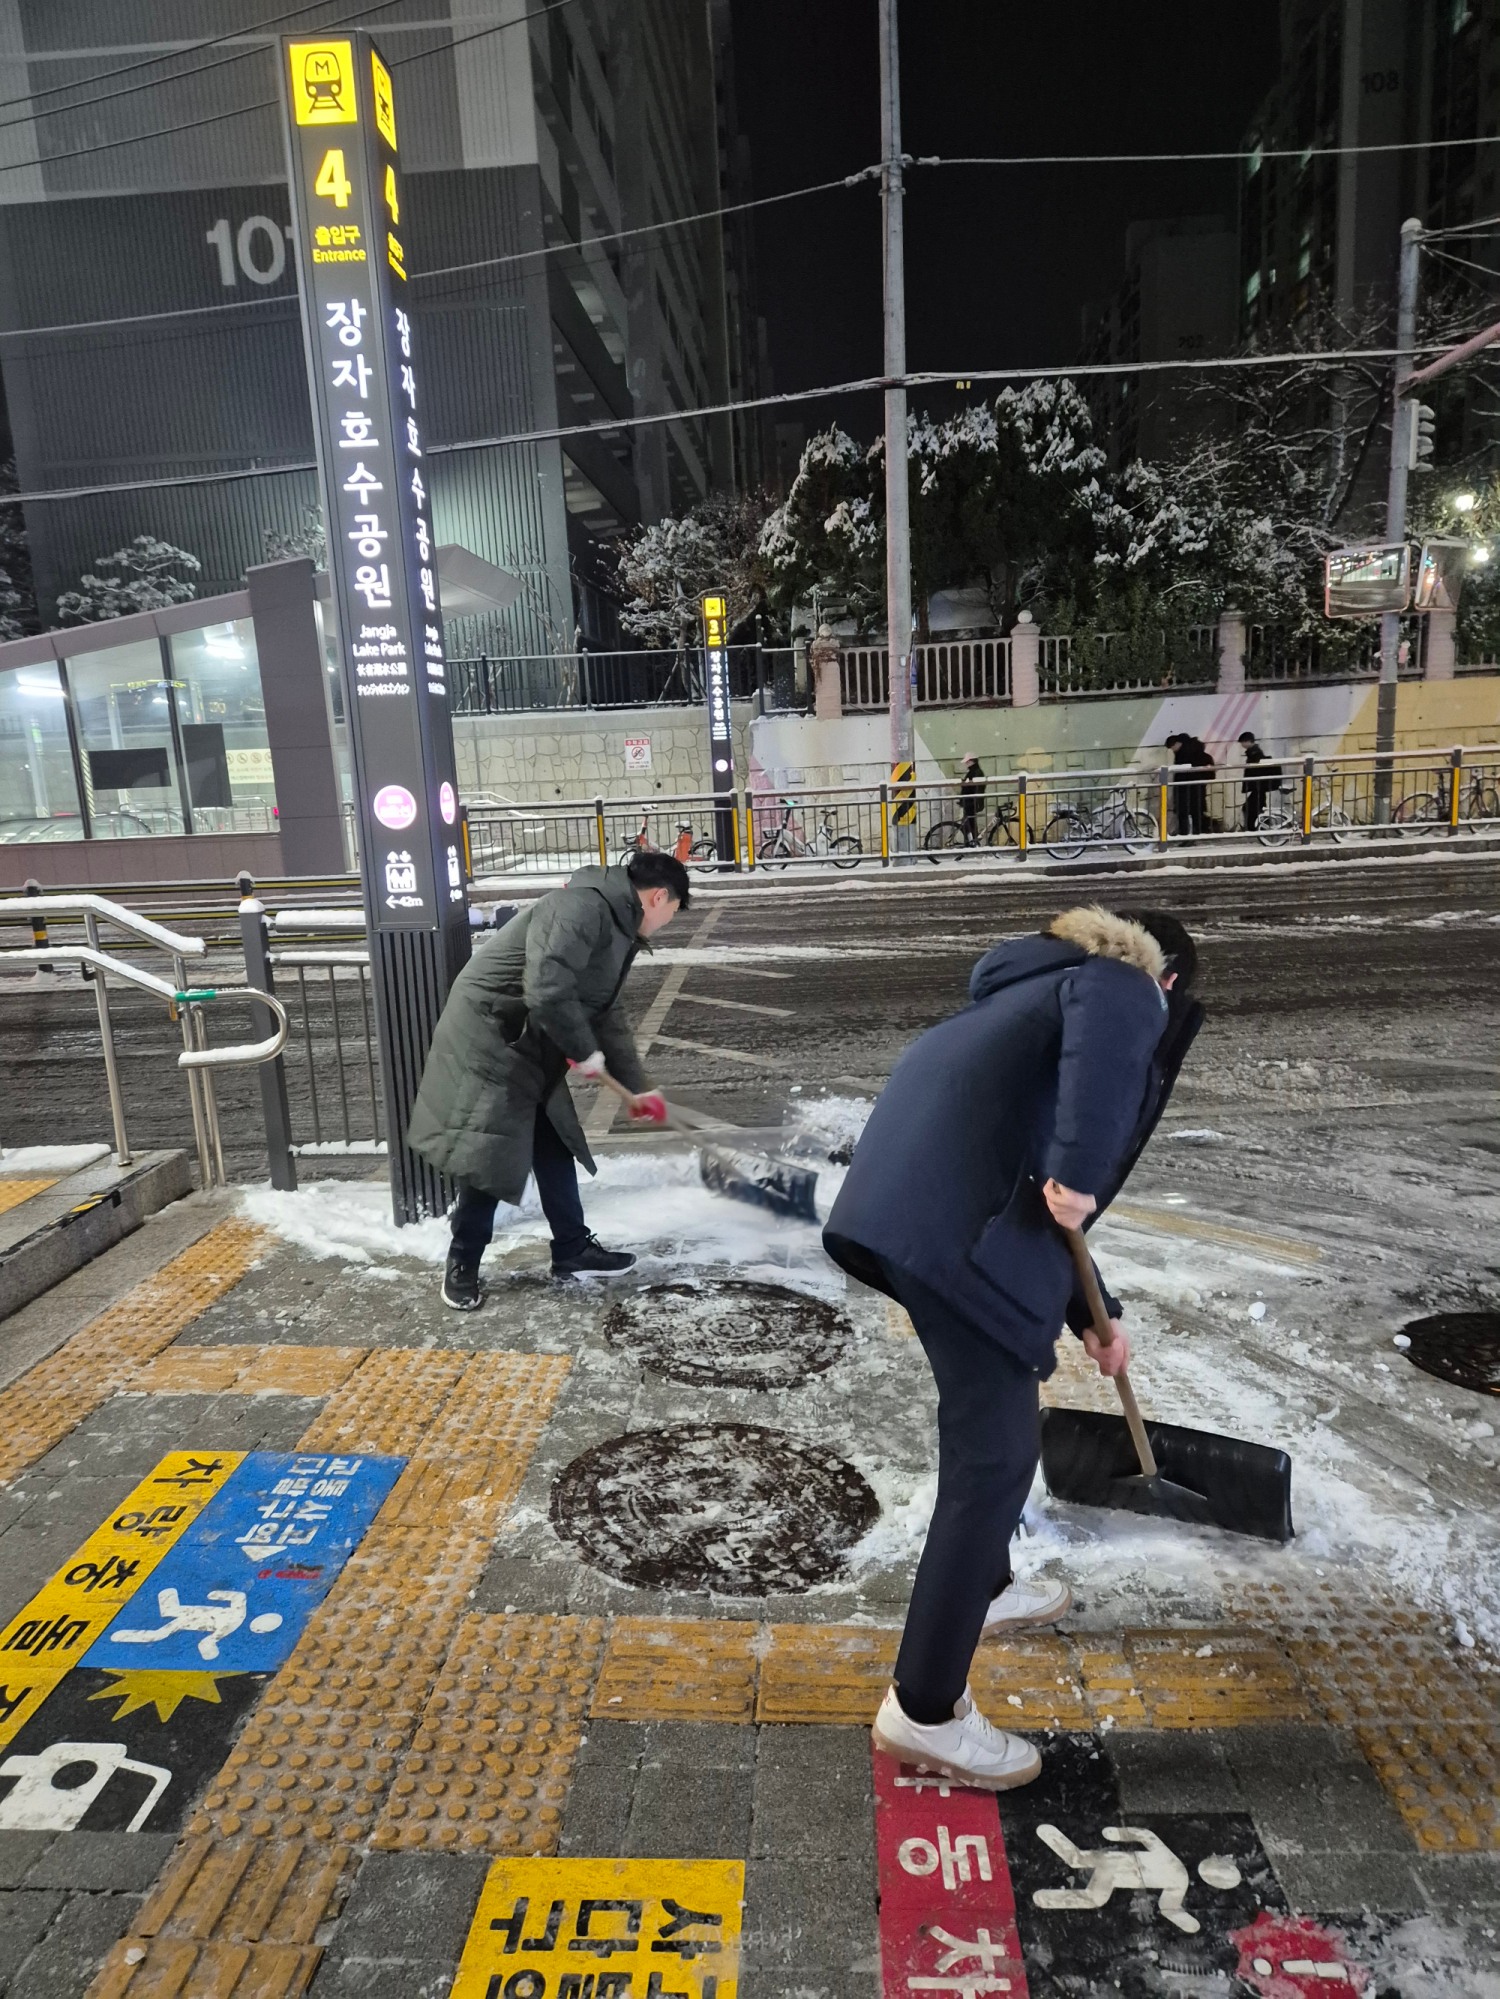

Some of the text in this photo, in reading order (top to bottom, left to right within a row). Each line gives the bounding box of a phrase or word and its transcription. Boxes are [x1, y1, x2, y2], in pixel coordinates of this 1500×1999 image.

[315, 149, 351, 208] 4
[385, 164, 399, 224] 4
[206, 215, 293, 286] 10
[312, 246, 367, 263] Entrance
[314, 225, 361, 246] 출입구
[325, 298, 392, 608] 장자호수공원
[395, 307, 436, 611] 장자호수공원
[352, 643, 380, 658] Lake
[381, 641, 407, 656] Park
[359, 623, 397, 641] Jangja
[709, 619, 719, 634] 3
[235, 1457, 327, 1546] 다발구역
[275, 1457, 364, 1546] 교통사고
